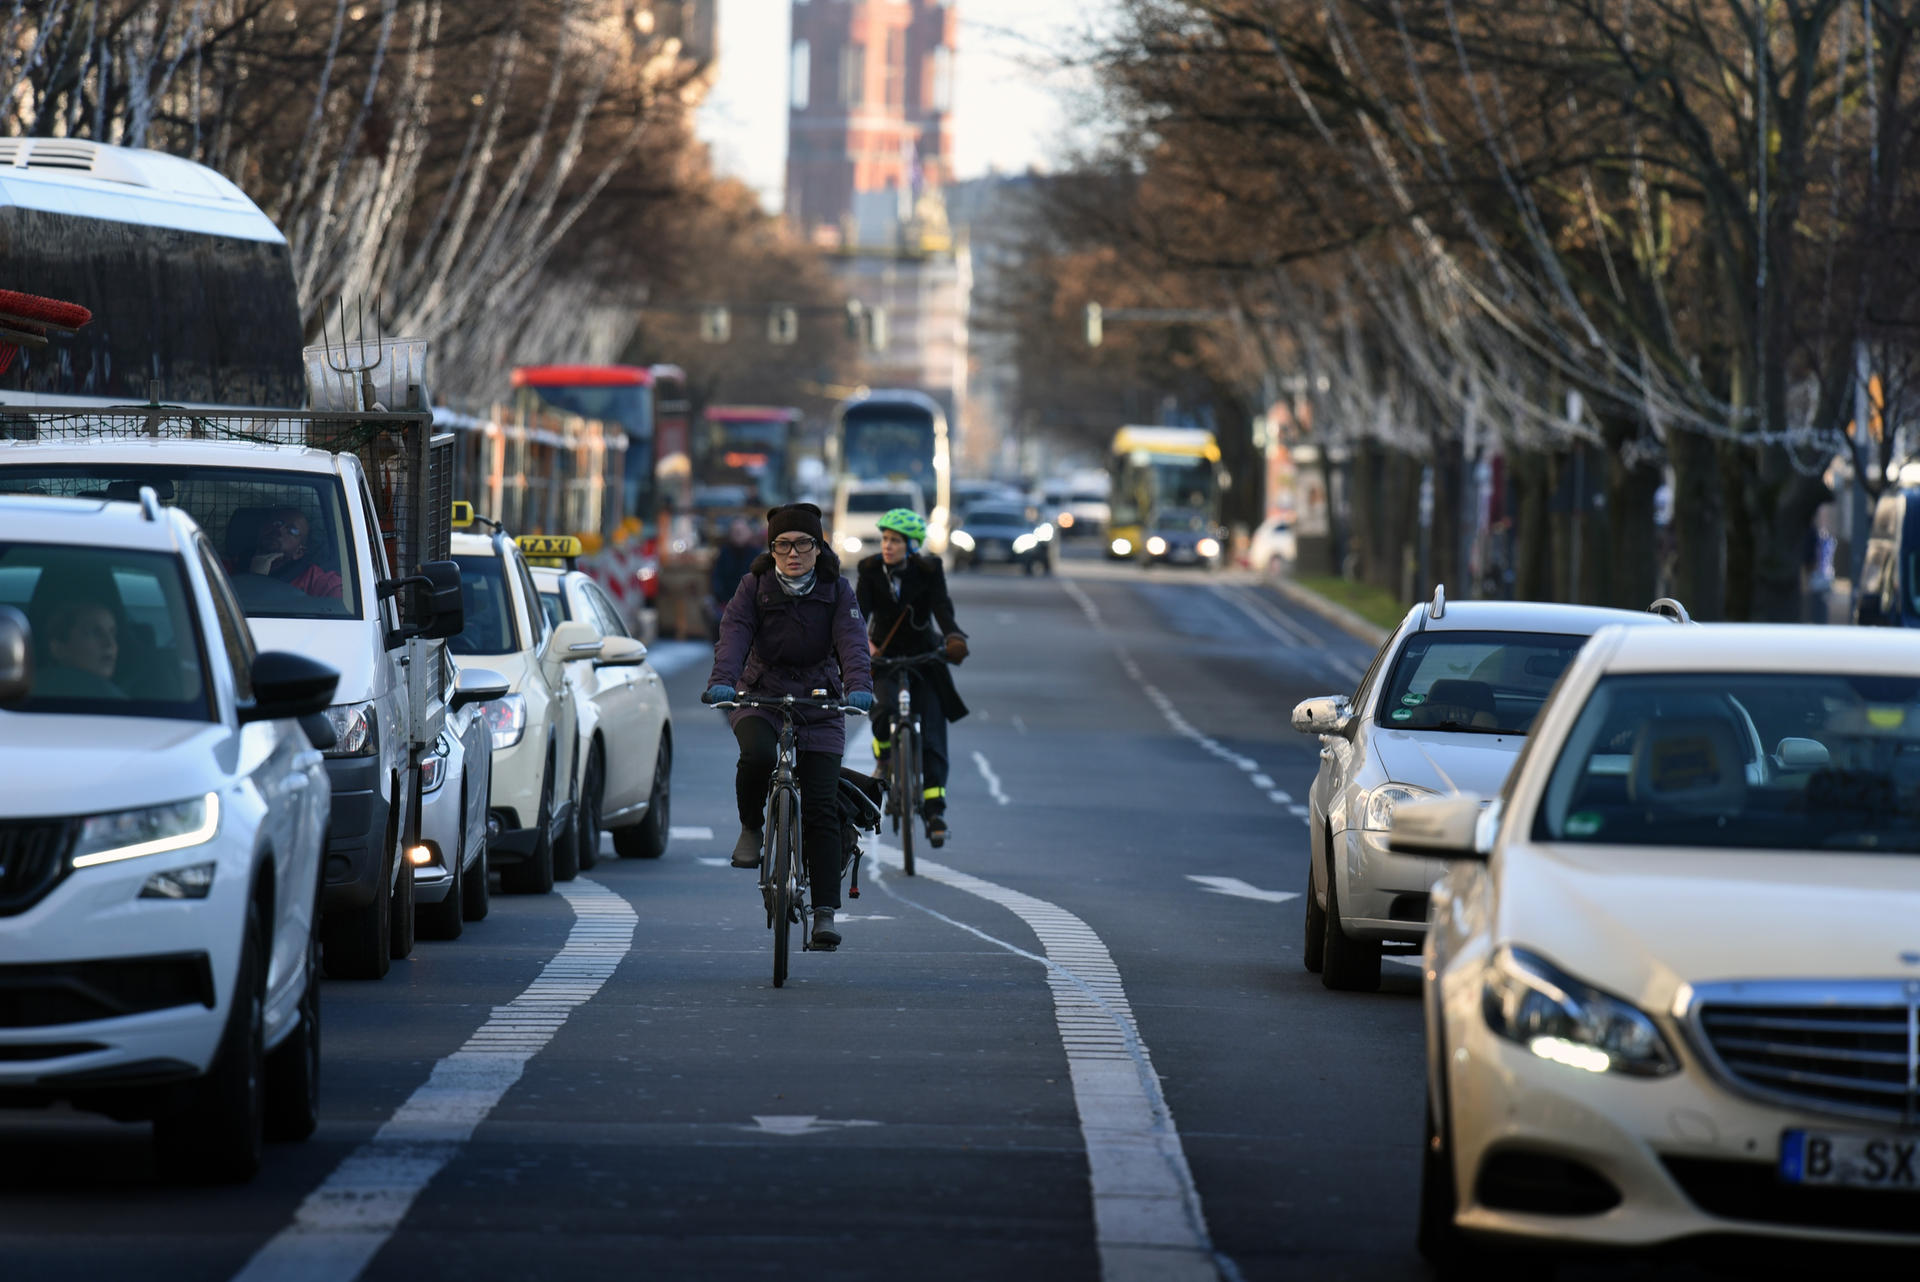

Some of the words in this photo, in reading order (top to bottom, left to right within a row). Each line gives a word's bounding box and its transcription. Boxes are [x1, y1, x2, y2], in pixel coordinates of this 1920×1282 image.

[523, 539, 569, 553] TAXI
[1808, 1138, 1832, 1177] B
[1864, 1140, 1916, 1183] SX
